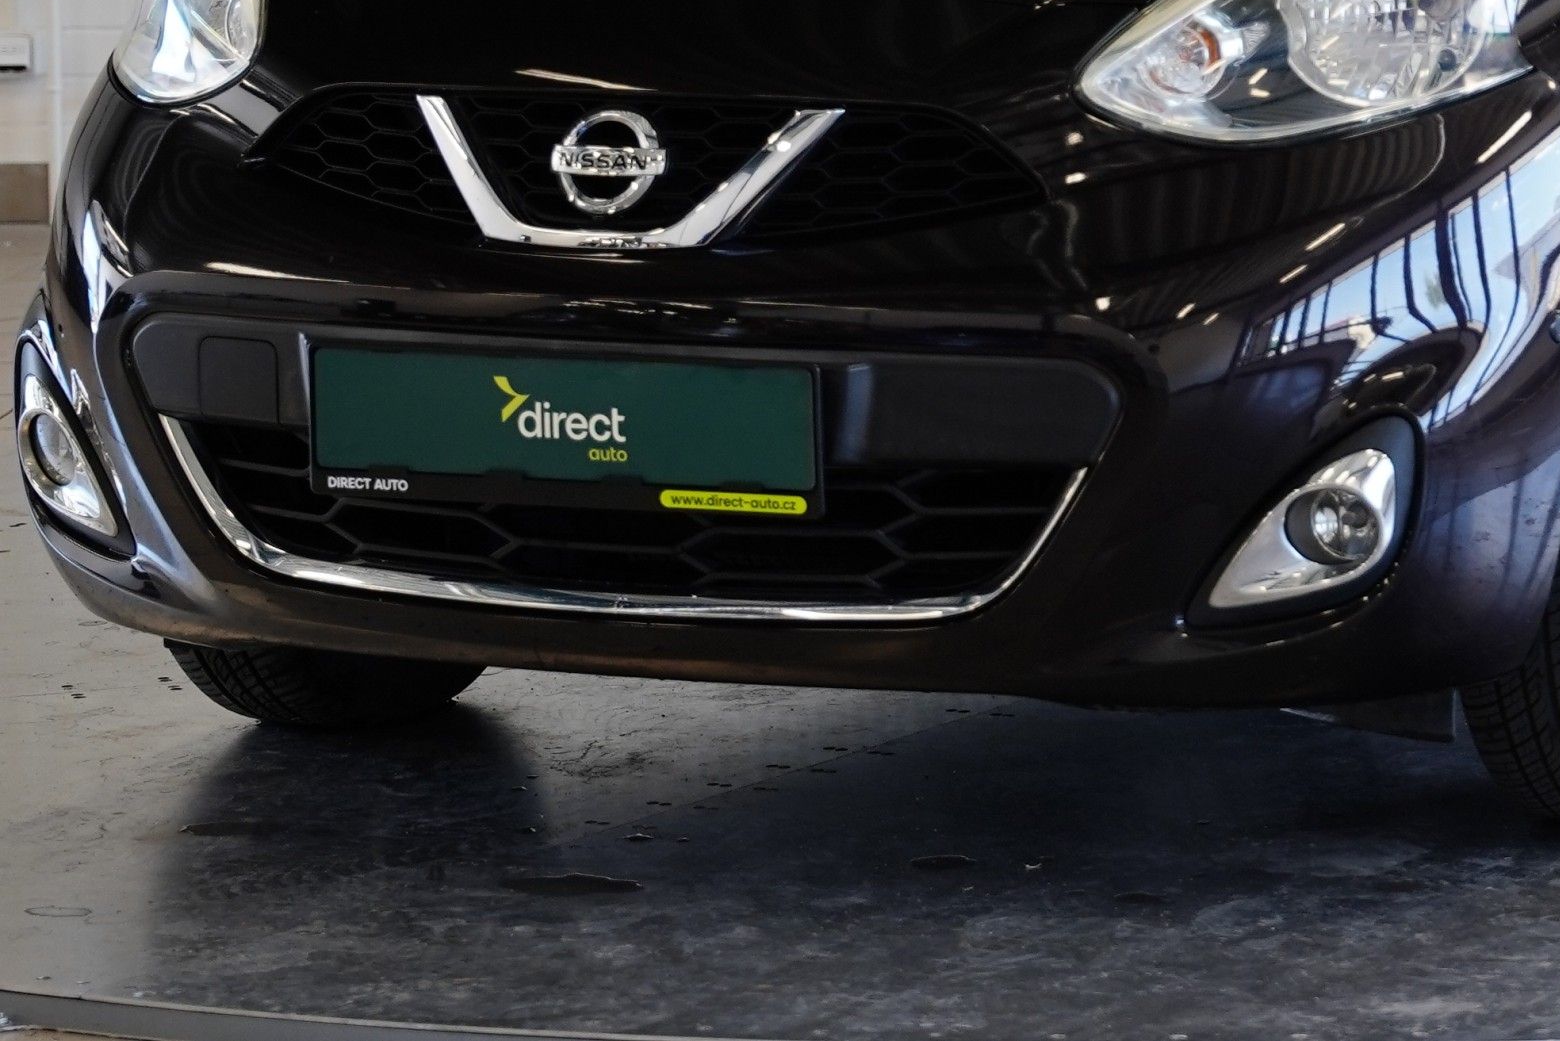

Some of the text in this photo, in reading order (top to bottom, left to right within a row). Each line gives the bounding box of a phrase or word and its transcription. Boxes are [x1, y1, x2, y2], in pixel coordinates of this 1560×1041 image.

[559, 151, 647, 170] NISSAN
[517, 401, 627, 443] direct
[588, 447, 628, 462] auto
[327, 476, 409, 491] DIRECT AUTO
[671, 494, 796, 511] www.direct-auto.cz
